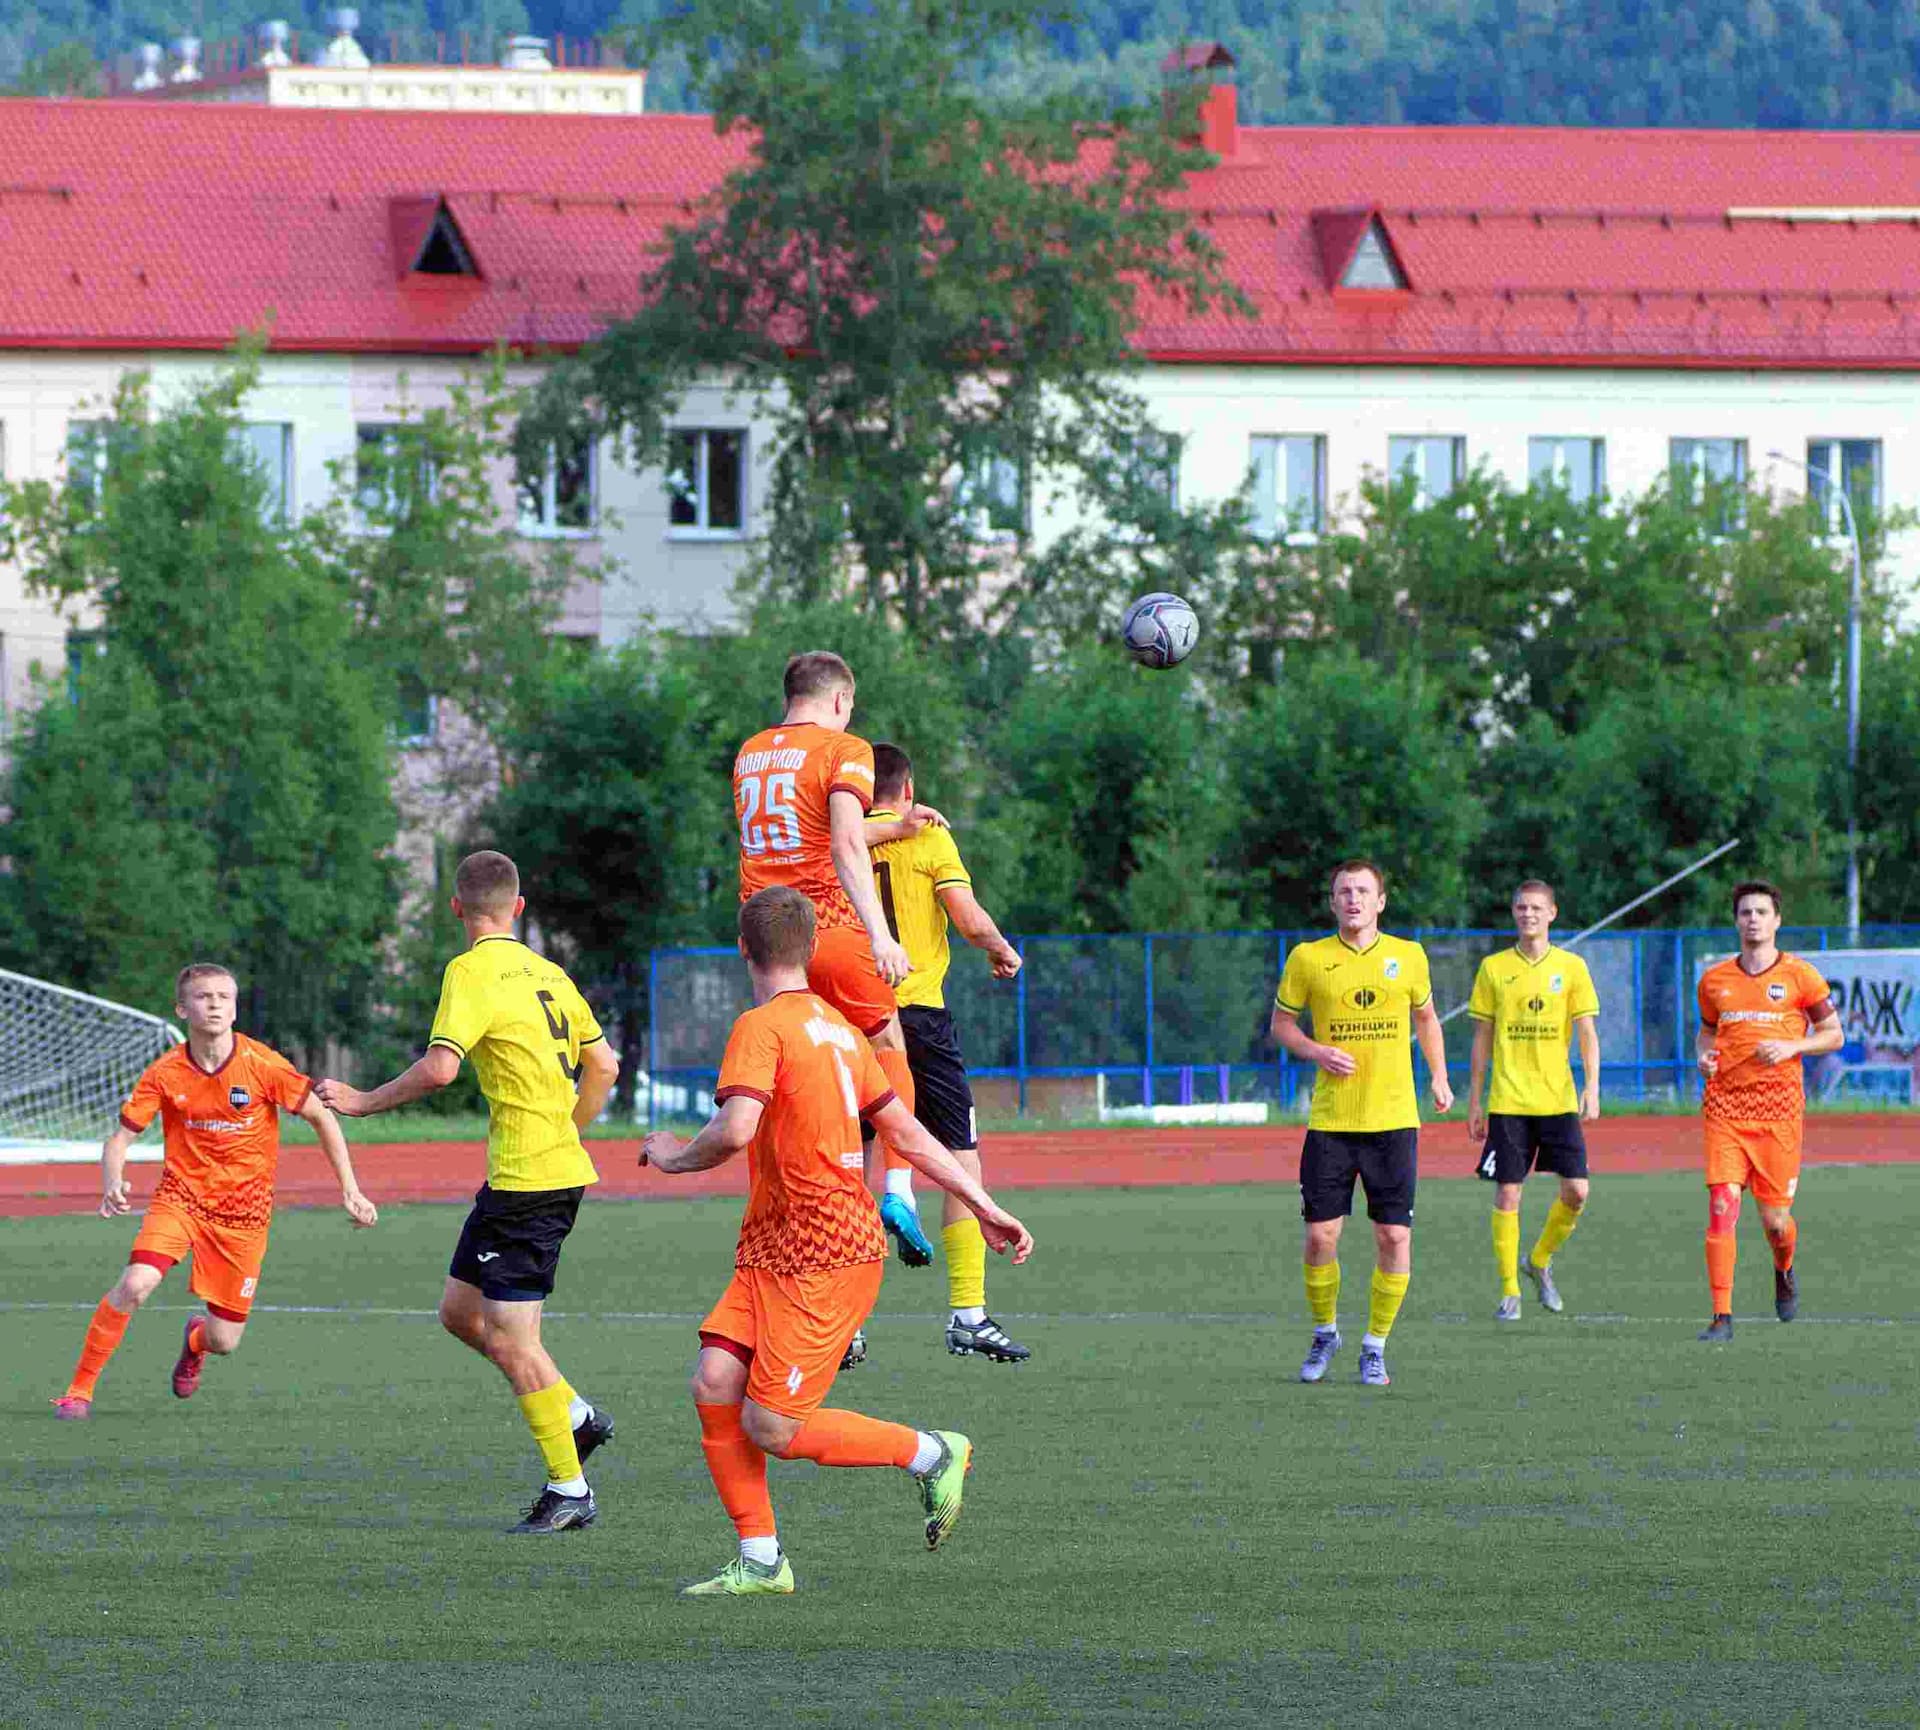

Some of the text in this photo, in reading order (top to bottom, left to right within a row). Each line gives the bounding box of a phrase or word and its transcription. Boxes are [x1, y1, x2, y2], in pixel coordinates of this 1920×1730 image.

[740, 772, 801, 856] 25
[1482, 1150, 1496, 1177] 4
[786, 1366, 803, 1396] 4
